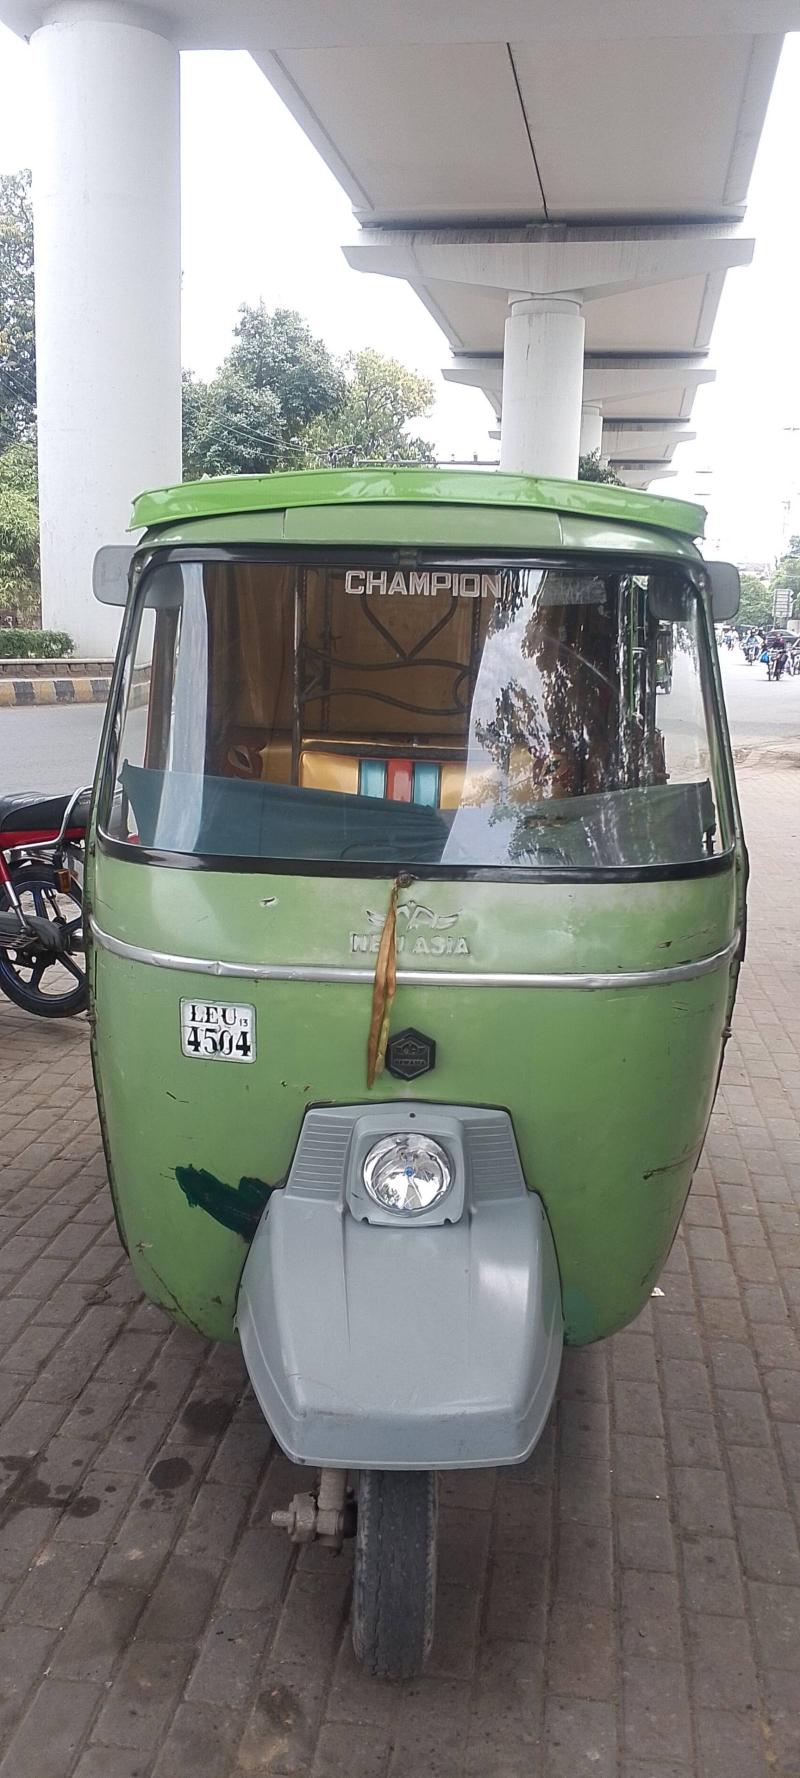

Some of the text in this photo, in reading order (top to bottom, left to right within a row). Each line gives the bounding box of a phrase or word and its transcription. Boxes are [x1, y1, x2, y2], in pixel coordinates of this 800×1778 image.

[345, 571, 501, 598] CHAMPION
[413, 935, 471, 955] ASIA
[190, 1004, 249, 1027] LEU 13
[187, 1026, 252, 1057] 4504
